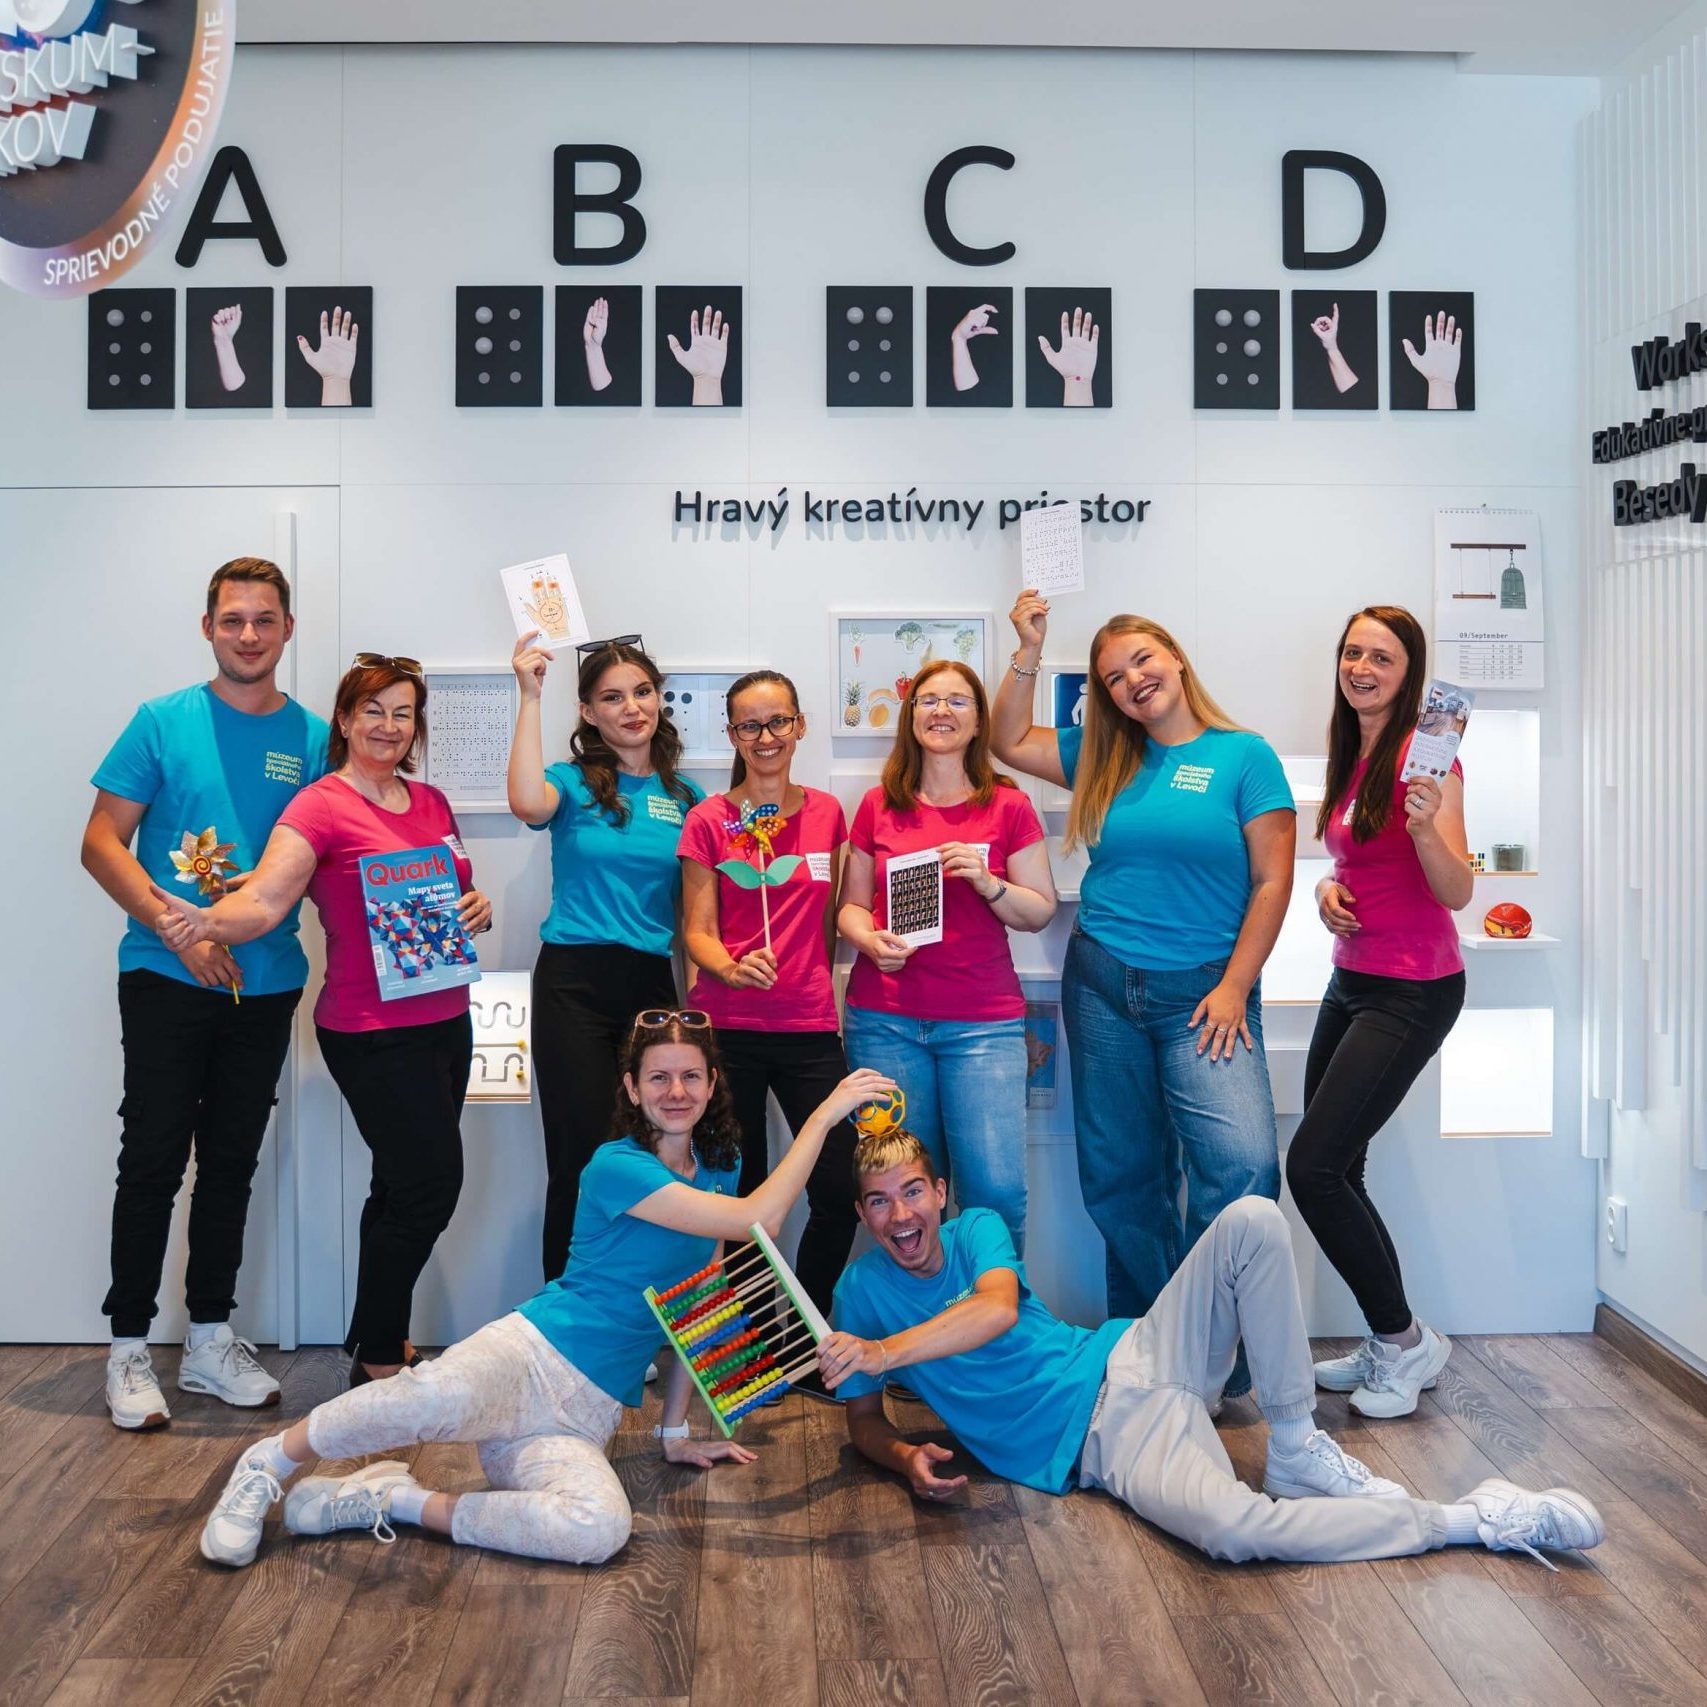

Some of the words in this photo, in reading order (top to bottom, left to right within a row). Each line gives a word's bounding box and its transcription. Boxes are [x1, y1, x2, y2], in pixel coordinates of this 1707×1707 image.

[43, 183, 170, 287] SPRIEVODNÉ
[166, 8, 224, 189] PODUJATIE
[175, 145, 287, 268] A
[553, 144, 647, 266] B
[924, 145, 1017, 267] C
[1282, 149, 1388, 270] D
[1592, 408, 1688, 464] Edukatívne
[674, 487, 789, 531] Hravý
[804, 487, 984, 531] kreatívny
[1000, 490, 1151, 531] pristor
[1613, 463, 1707, 527] Besedy
[1459, 632, 1508, 640] 09/September
[267, 752, 302, 764] múzeum
[366, 853, 449, 886] Quark
[407, 885, 431, 896] Mapy
[431, 882, 454, 892] sveta
